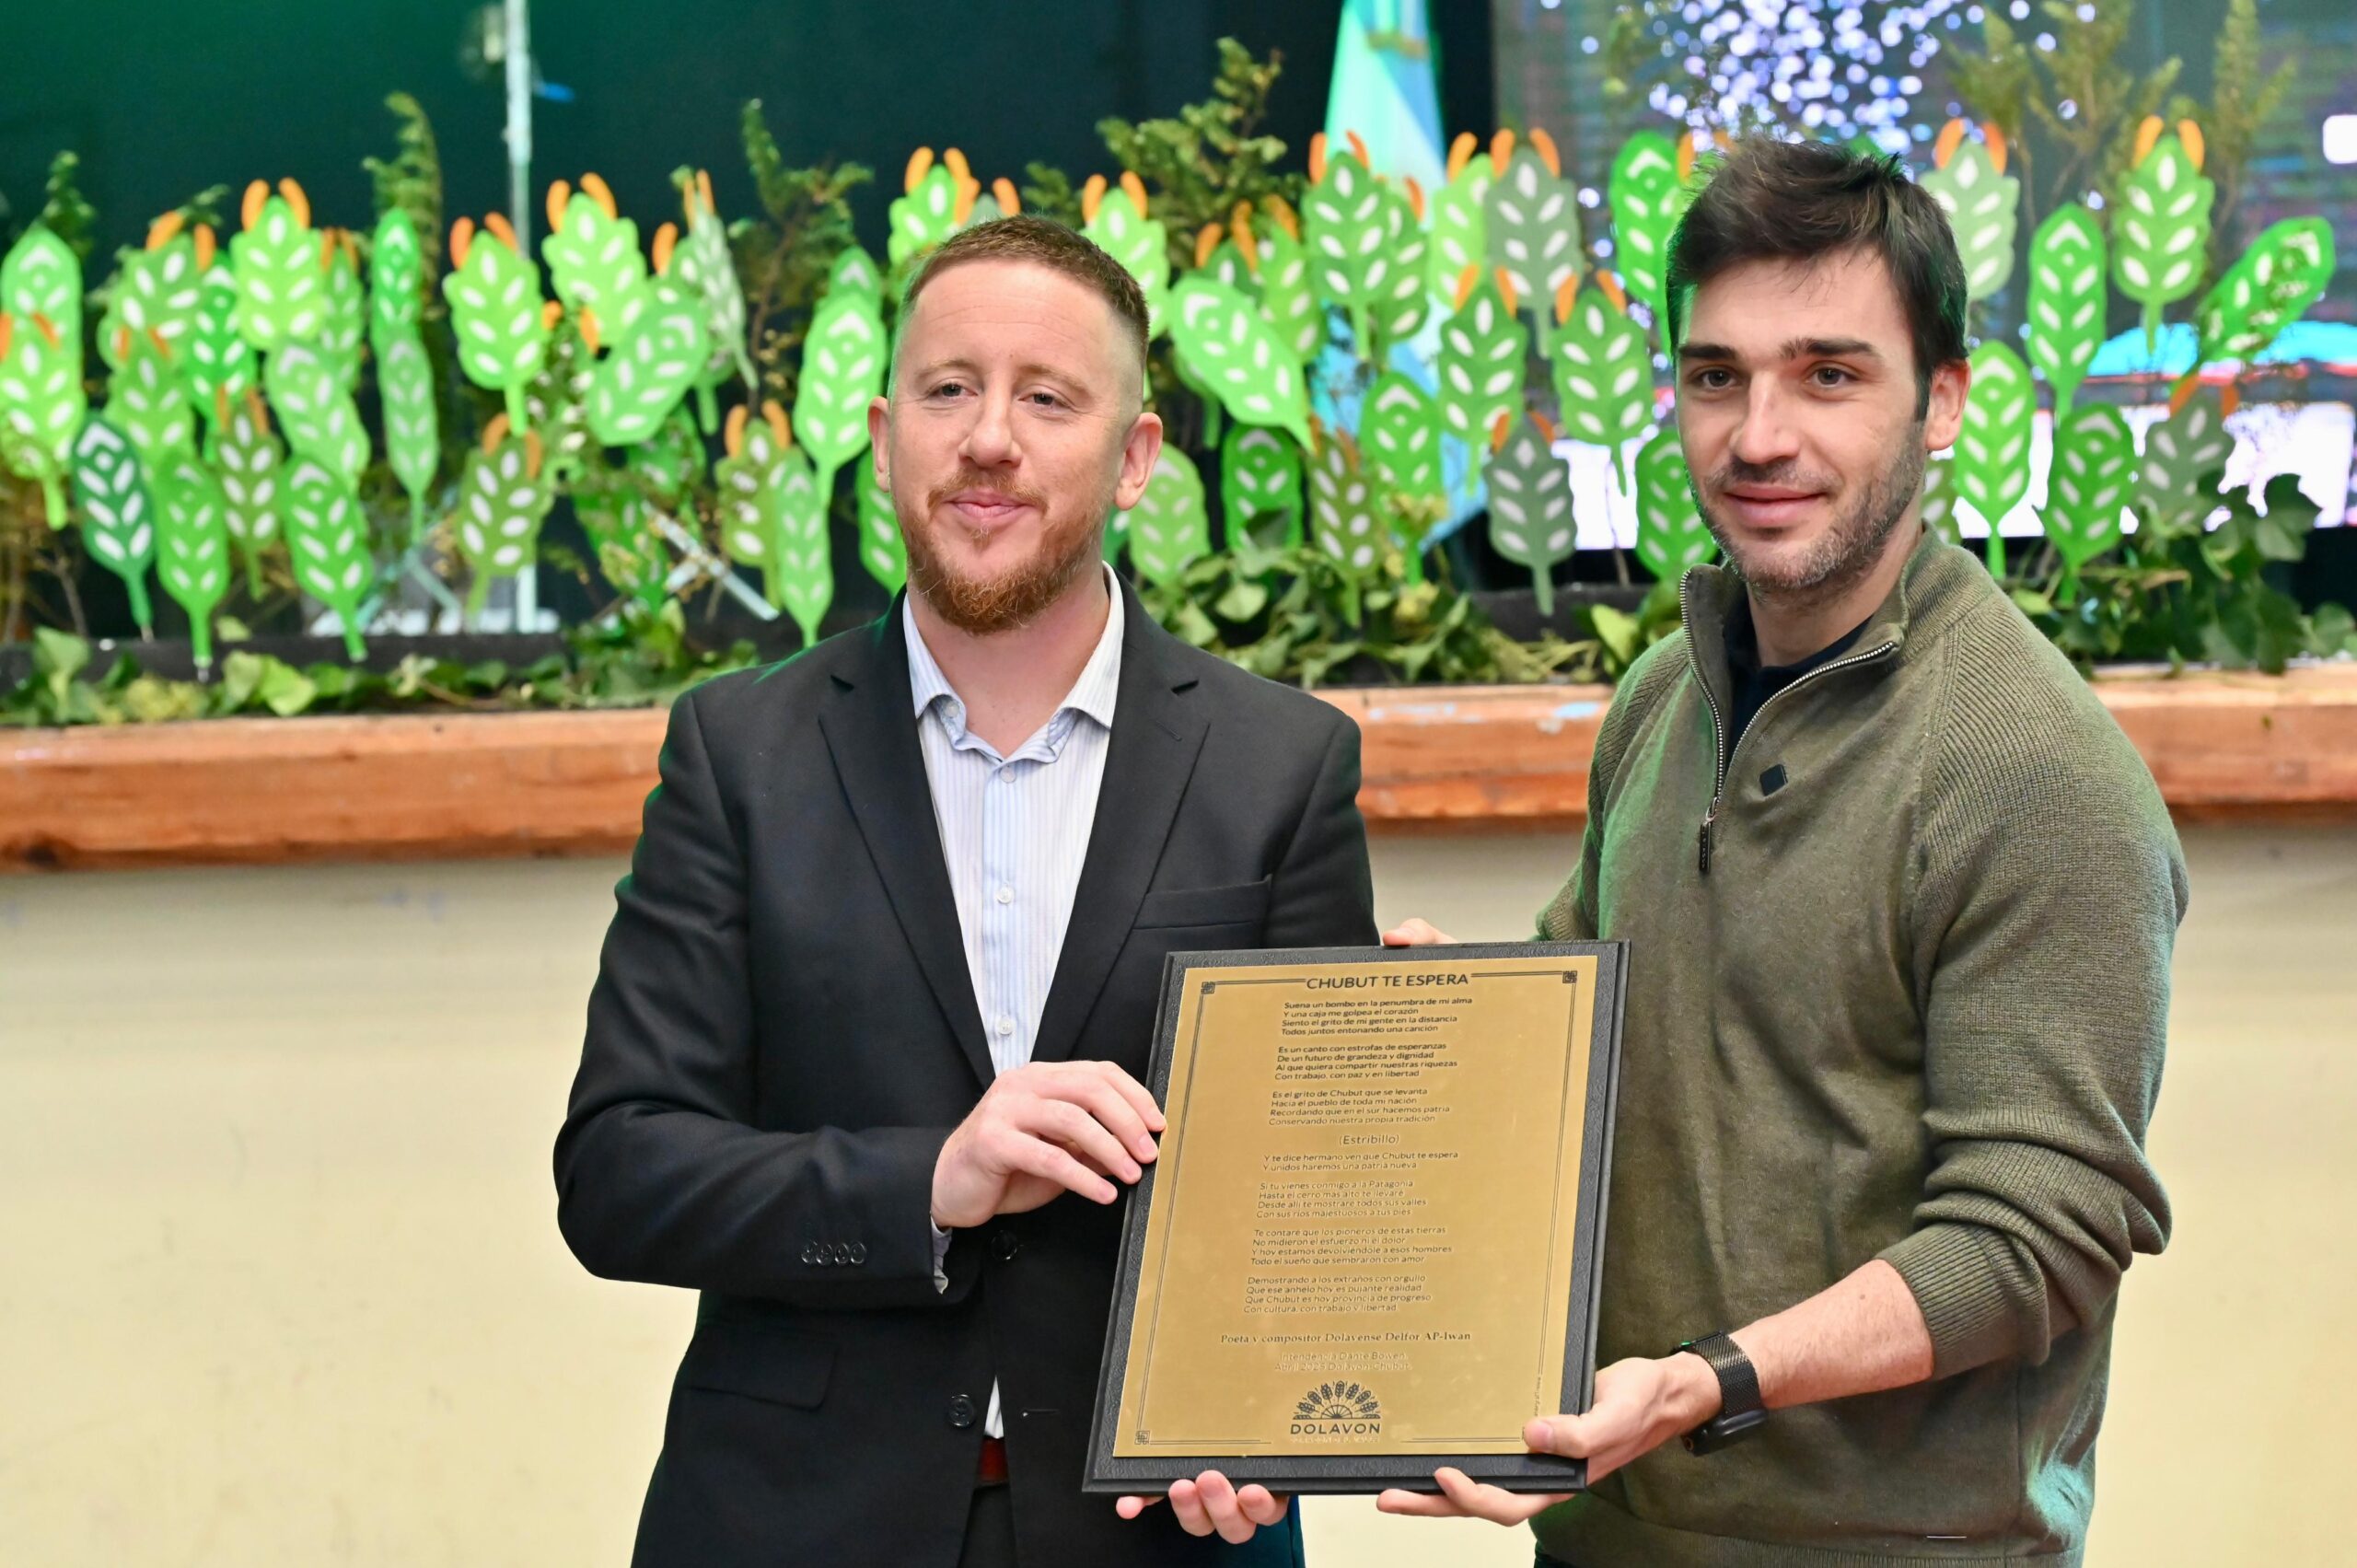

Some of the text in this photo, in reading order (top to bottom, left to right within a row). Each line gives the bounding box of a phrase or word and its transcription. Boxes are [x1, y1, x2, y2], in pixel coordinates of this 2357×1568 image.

[1306, 974, 1469, 989] CHUBUT TE ESPERA
[1380, 998, 1424, 1007] penumbra
[1347, 1052, 1387, 1062] grandeza
[1396, 1051, 1434, 1060] dignidad
[1334, 1063, 1380, 1071] compartir
[1420, 1060, 1458, 1068] riquezas
[1307, 1099, 1337, 1108] pueblo
[1365, 1116, 1394, 1124] propia
[1339, 1134, 1400, 1145] (Estribillo)
[1362, 1162, 1388, 1170] patria
[1261, 1335, 1322, 1343] compositor
[1290, 1423, 1380, 1434] DOLAVON
